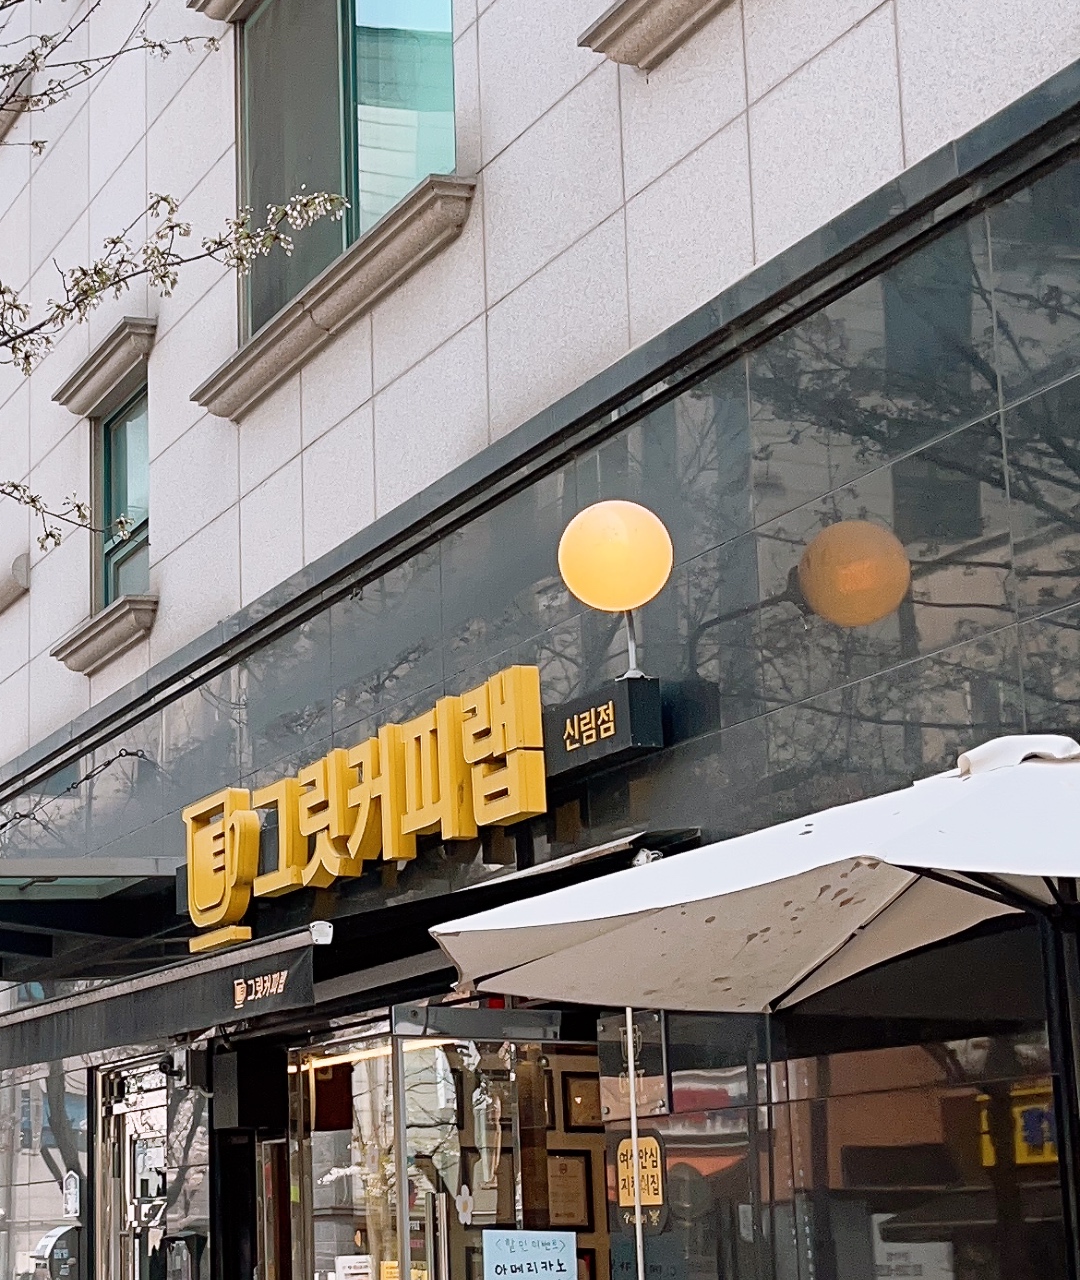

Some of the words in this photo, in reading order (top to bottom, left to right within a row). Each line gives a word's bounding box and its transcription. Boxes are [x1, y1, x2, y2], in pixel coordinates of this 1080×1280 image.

[563, 700, 616, 752] 신림점
[252, 665, 546, 898] 그릿커피랩
[494, 1258, 568, 1276] 아메리카노
